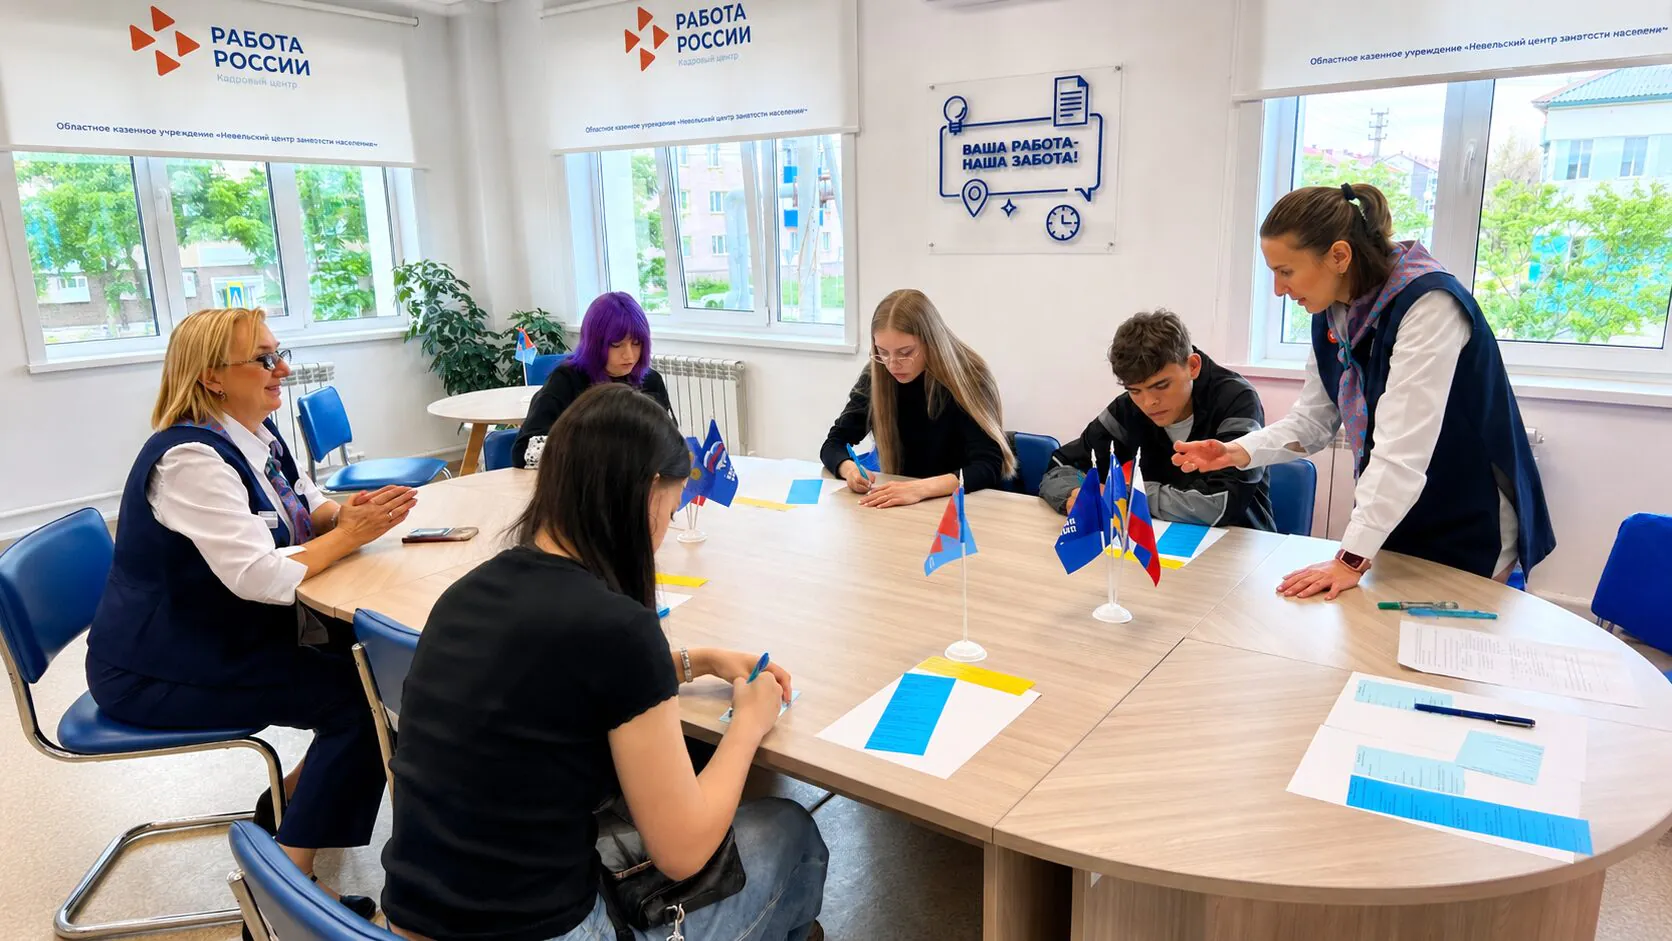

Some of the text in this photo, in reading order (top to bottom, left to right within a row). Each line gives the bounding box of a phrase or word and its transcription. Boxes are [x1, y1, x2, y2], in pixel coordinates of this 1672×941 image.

[676, 3, 746, 30] РАБОТА
[211, 26, 304, 54] РАБОТА
[677, 25, 751, 53] РОССИИ
[1310, 55, 1358, 65] Областное
[1360, 51, 1402, 61] казенное
[1404, 45, 1462, 58] учреждение
[1527, 36, 1557, 46] центр
[213, 50, 311, 76] РОССИИ
[217, 74, 298, 90] Кадровый центр
[56, 121, 111, 133] Областное
[112, 126, 157, 135] казенное
[159, 128, 214, 138] учреждение
[271, 135, 295, 143] центр
[963, 137, 1078, 155] ВАША РАБОТА-
[962, 151, 1078, 170] НАША ЗАБОТА!
